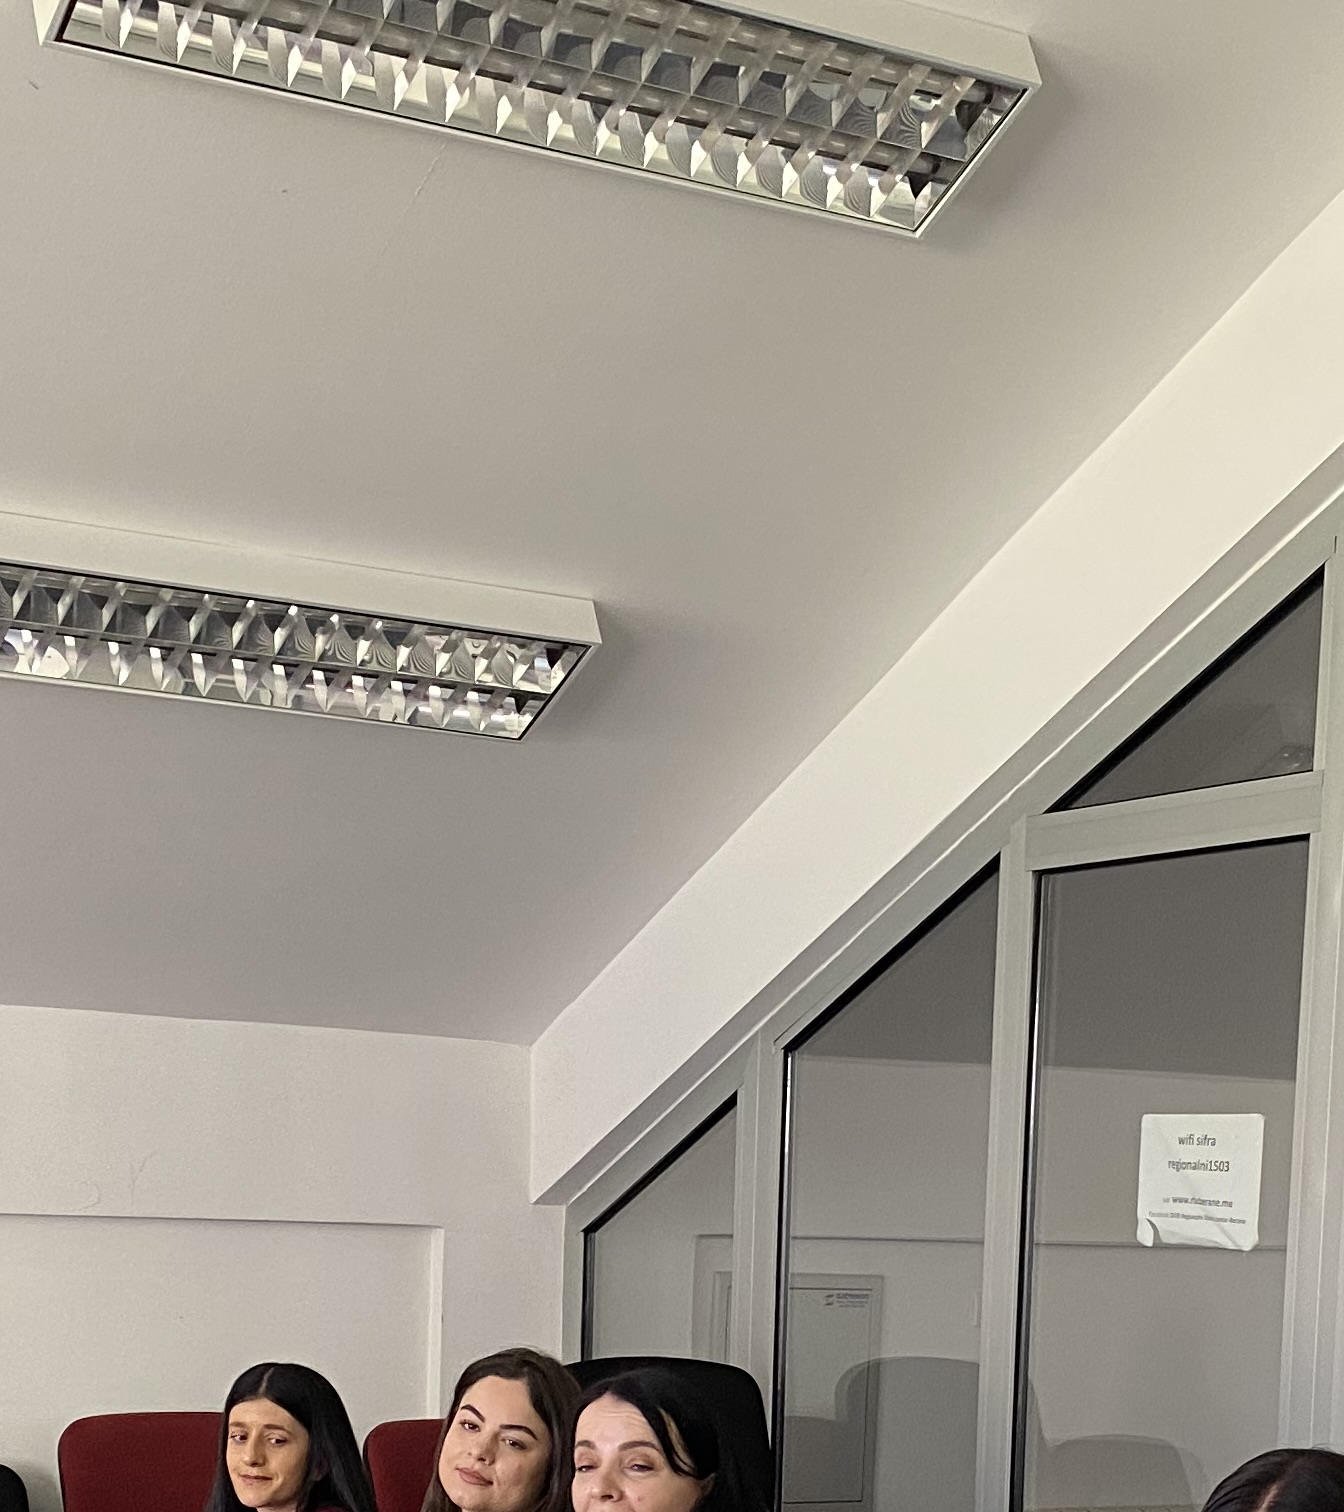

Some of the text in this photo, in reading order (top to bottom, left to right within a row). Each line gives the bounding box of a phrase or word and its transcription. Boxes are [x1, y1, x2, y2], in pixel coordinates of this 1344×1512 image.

[1178, 1133, 1217, 1147] wifi sifra
[1167, 1158, 1230, 1172] regionalni1503
